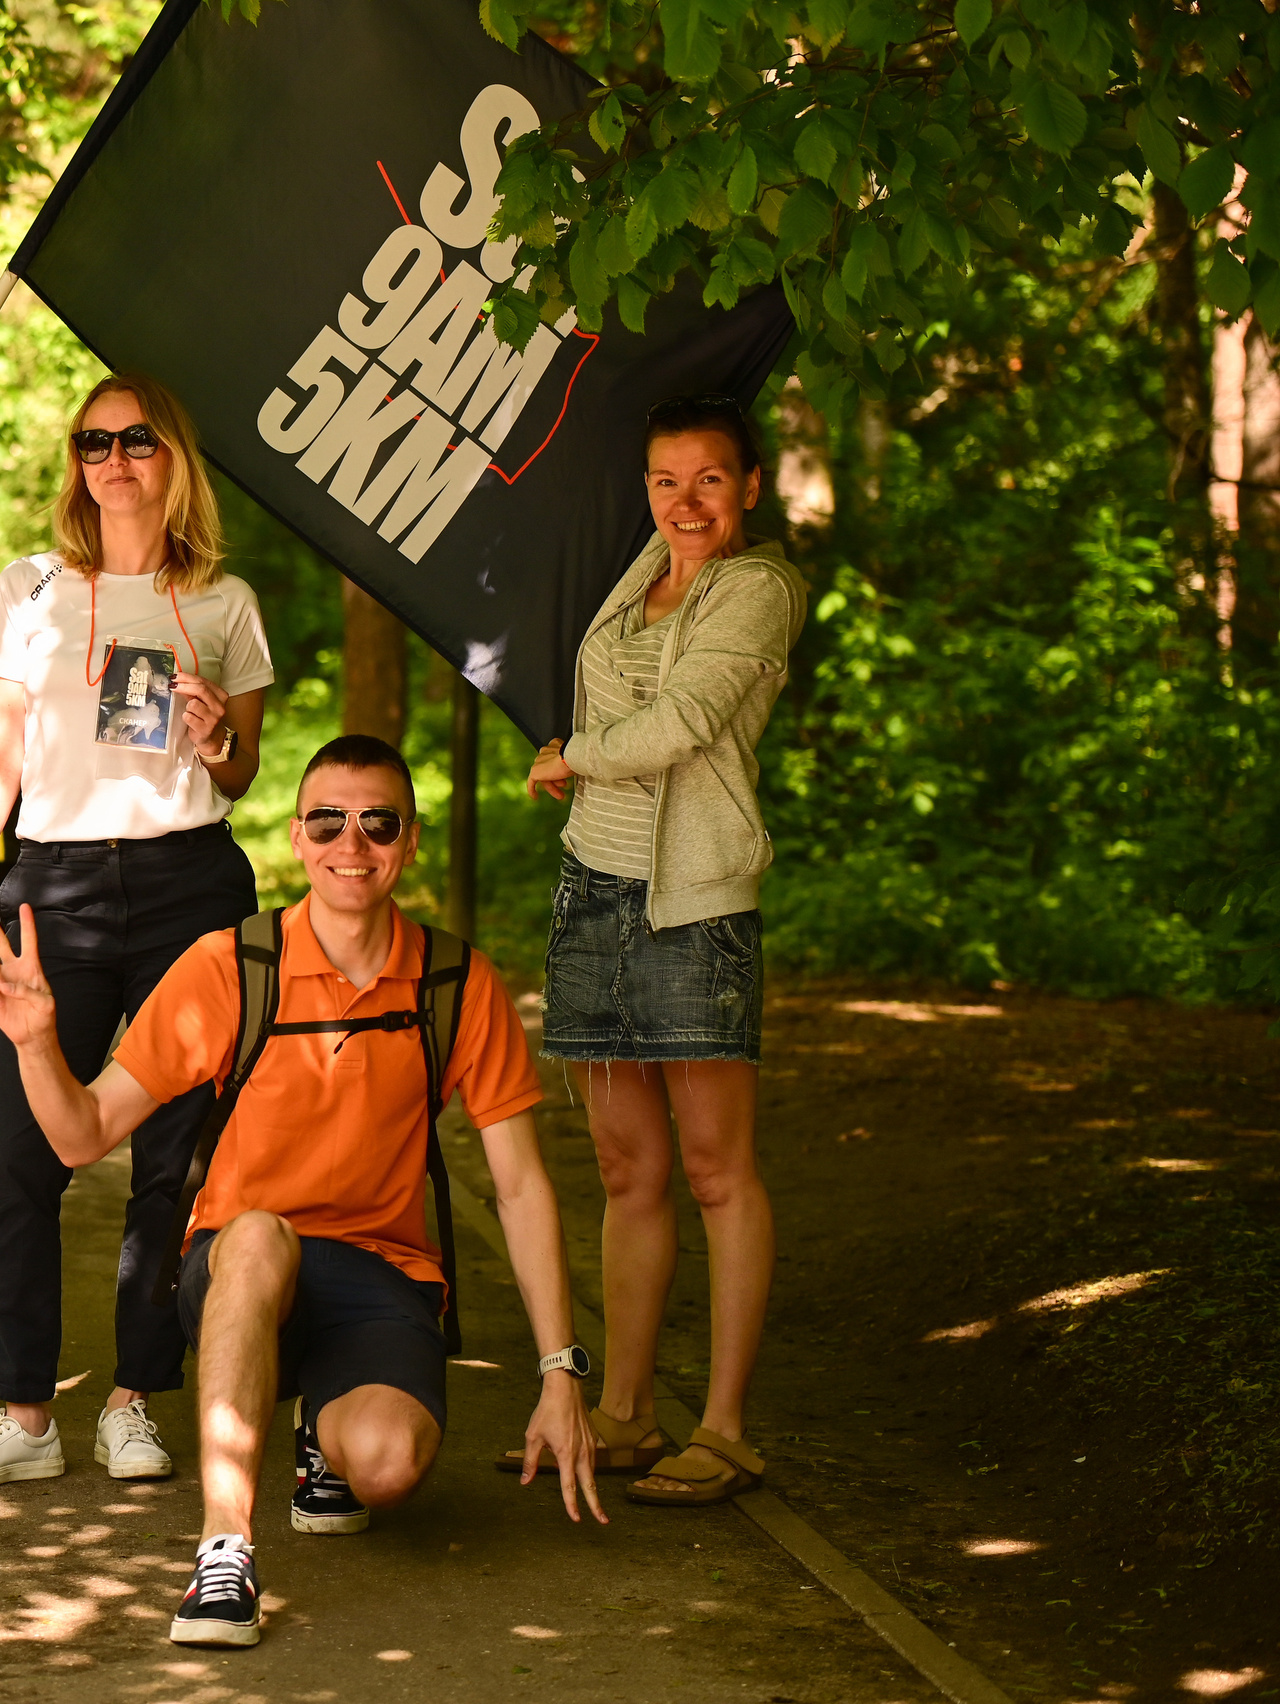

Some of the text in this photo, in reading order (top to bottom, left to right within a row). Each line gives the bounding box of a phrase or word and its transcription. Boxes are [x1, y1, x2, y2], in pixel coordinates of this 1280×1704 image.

[338, 225, 563, 454] 9AM
[257, 325, 493, 566] 5KM
[30, 570, 57, 601] CRAFT
[129, 667, 149, 684] Sat
[127, 682, 148, 696] 9AM
[125, 693, 147, 707] 5KM
[119, 717, 148, 727] СКАНЕР
